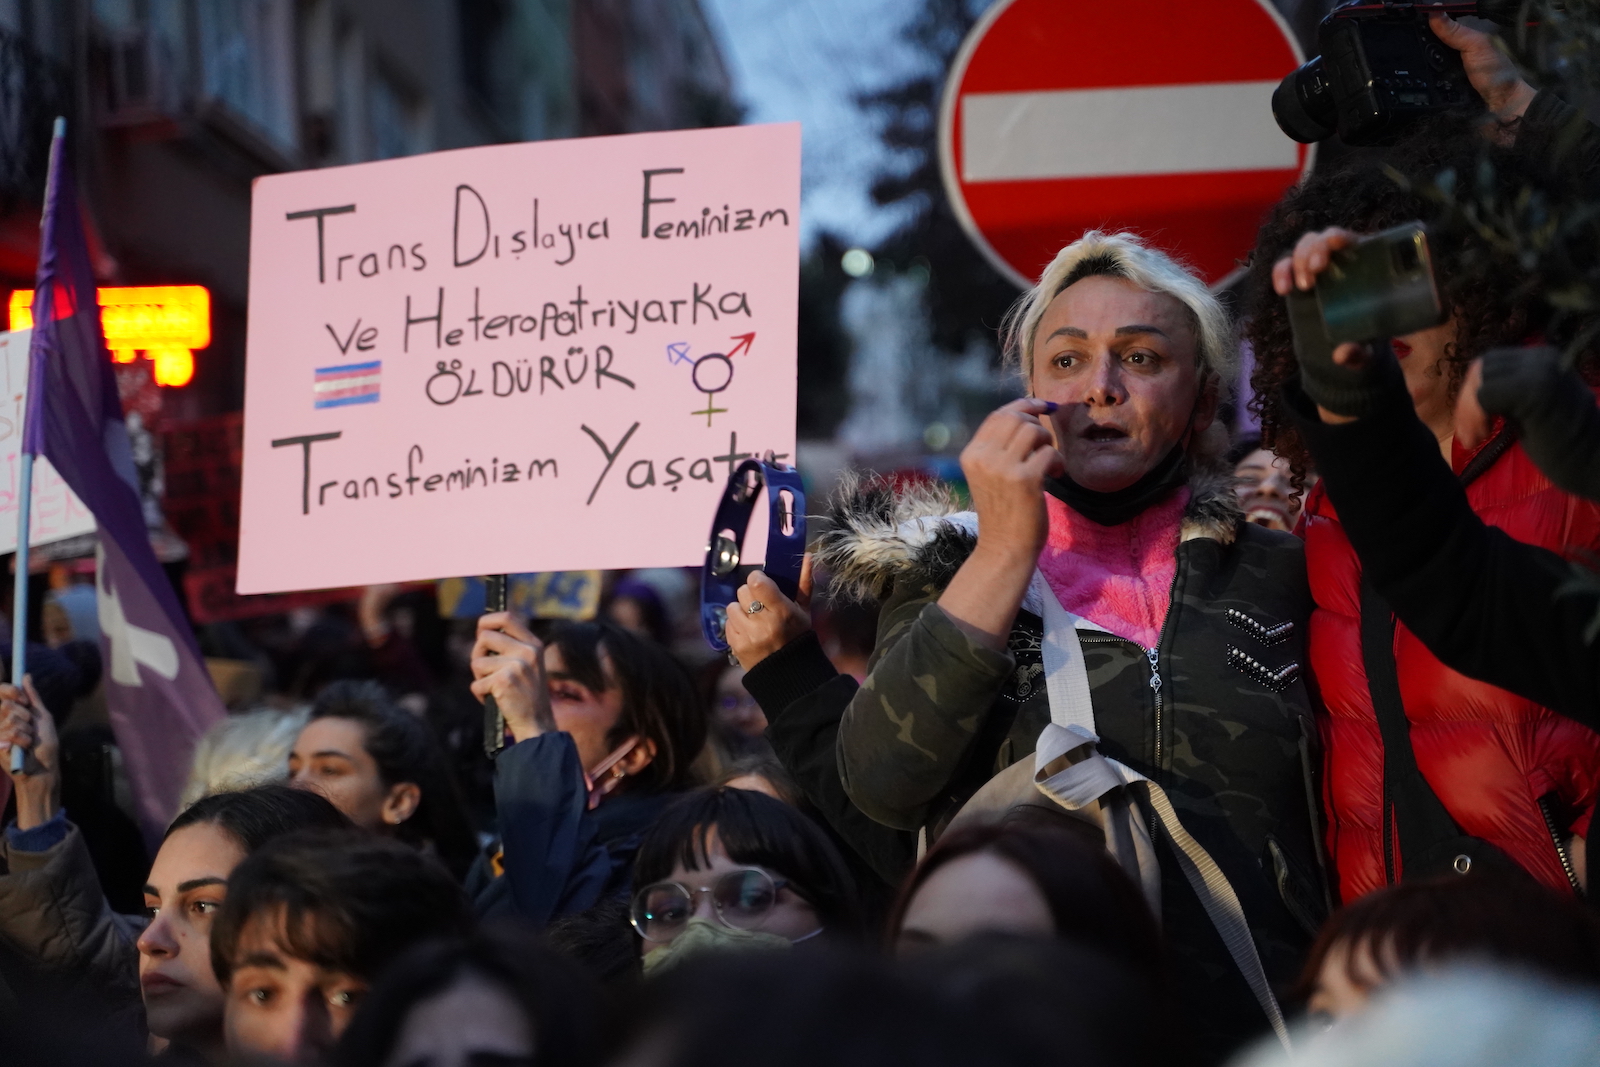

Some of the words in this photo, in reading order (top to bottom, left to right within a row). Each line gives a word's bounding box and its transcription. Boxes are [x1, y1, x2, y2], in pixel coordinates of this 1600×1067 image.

[284, 203, 427, 284] Trans
[452, 183, 610, 268] Dışlayıcı
[640, 167, 790, 240] Feminizm
[425, 344, 636, 407] ÖLDÜRÜR
[270, 430, 558, 516] Transfeminizm
[580, 421, 790, 506] Yaşat
